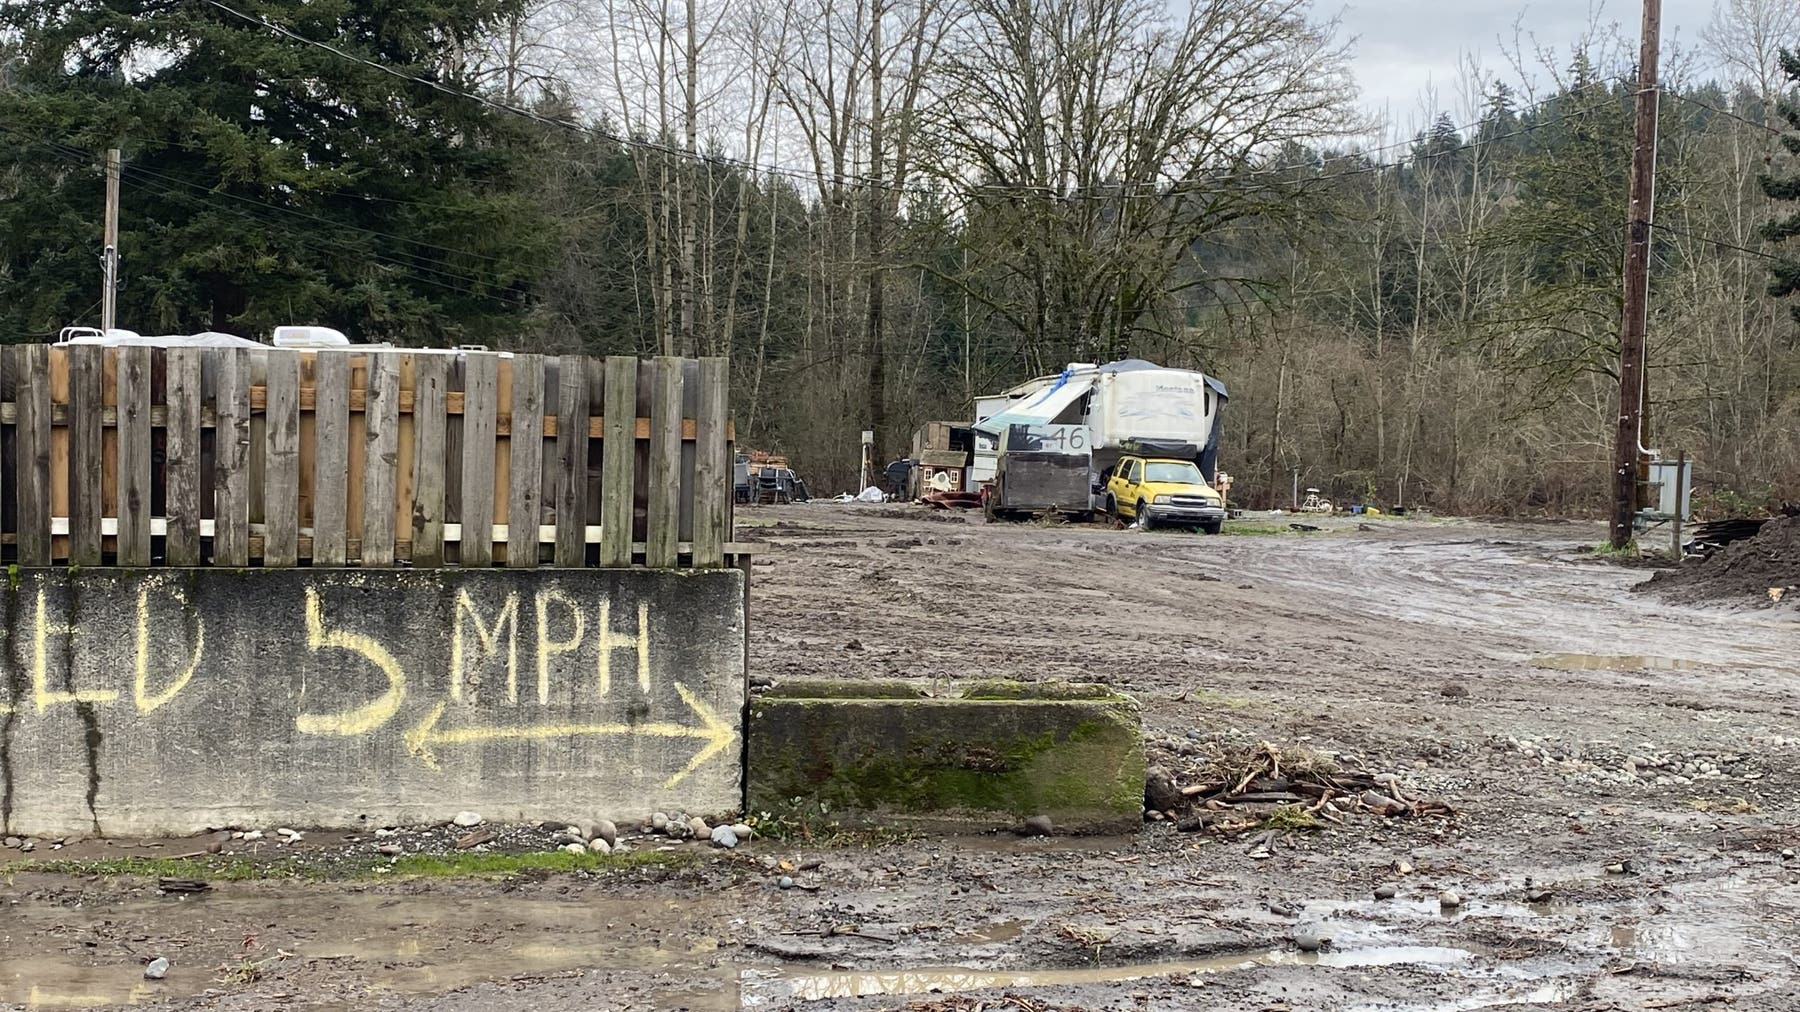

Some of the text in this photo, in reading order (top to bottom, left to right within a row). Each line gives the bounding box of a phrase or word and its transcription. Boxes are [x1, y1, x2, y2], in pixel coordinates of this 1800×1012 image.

[1051, 427, 1084, 450] 46
[0, 574, 652, 736] ED 5 MPH
